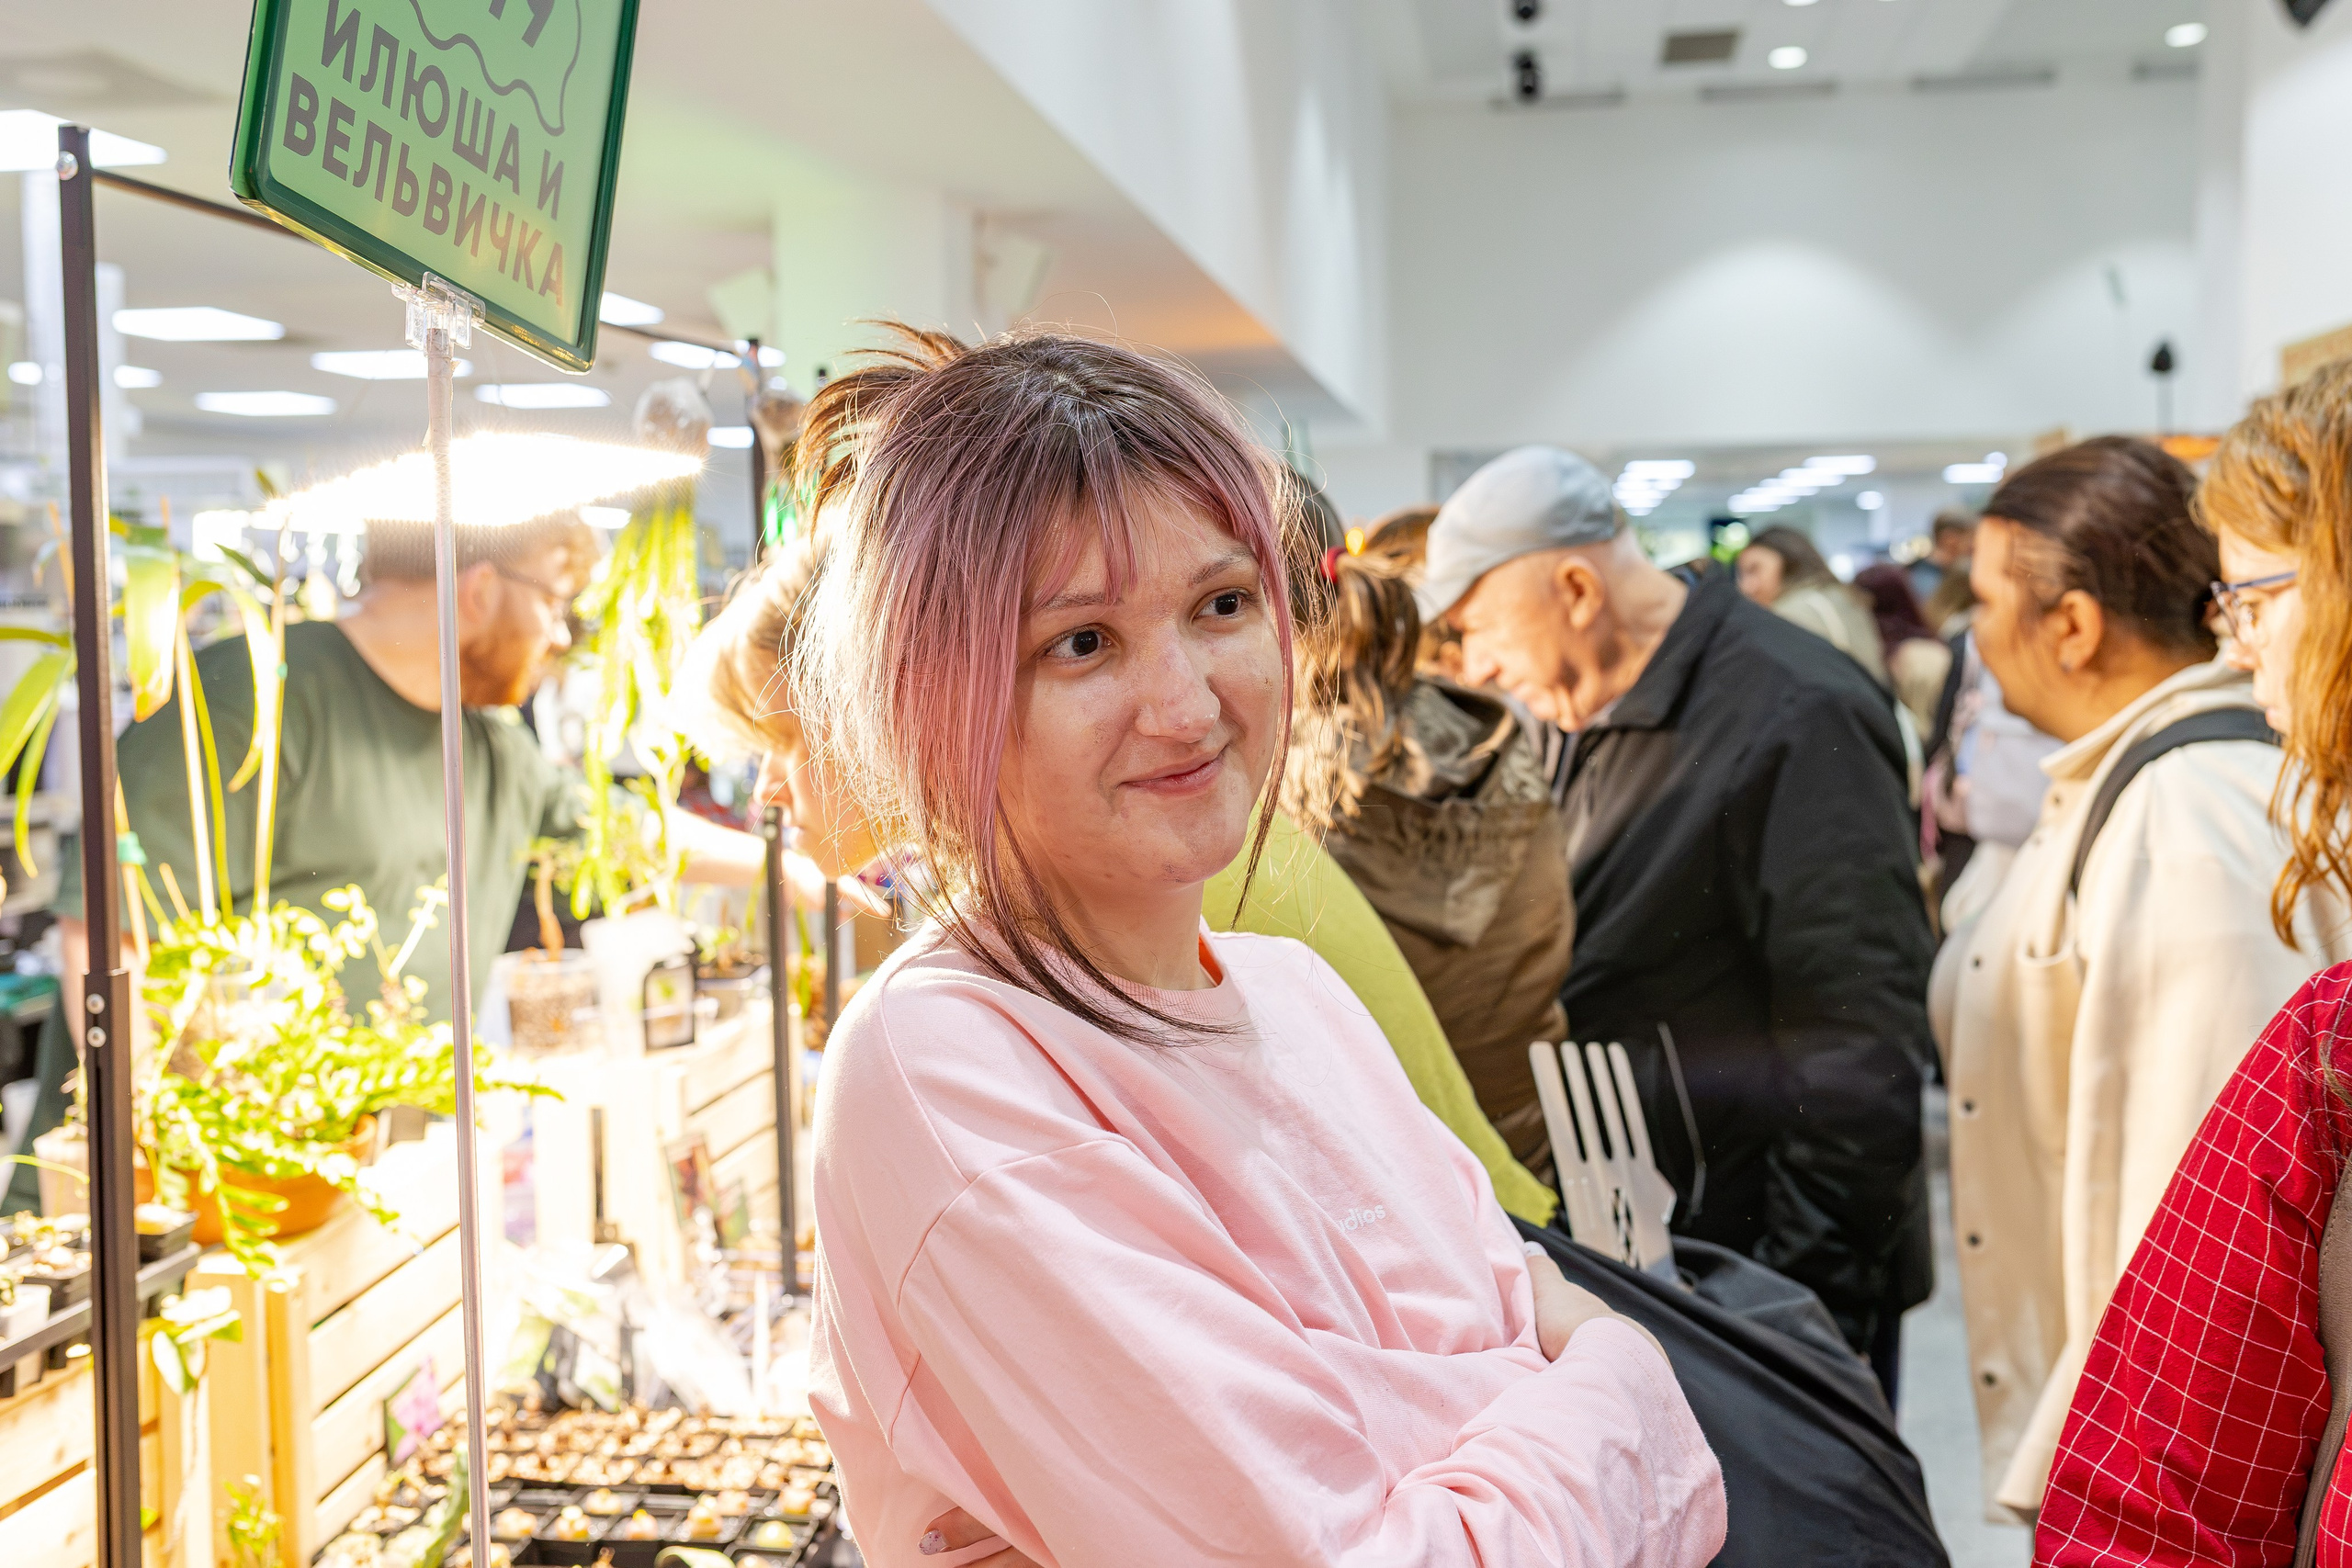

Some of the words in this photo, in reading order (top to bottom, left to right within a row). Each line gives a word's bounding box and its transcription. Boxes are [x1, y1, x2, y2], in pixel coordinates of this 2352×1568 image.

[283, 72, 564, 307] ВЕЛЬВИЧКА
[321, 0, 520, 195] ИЛЮША
[537, 149, 564, 221] И
